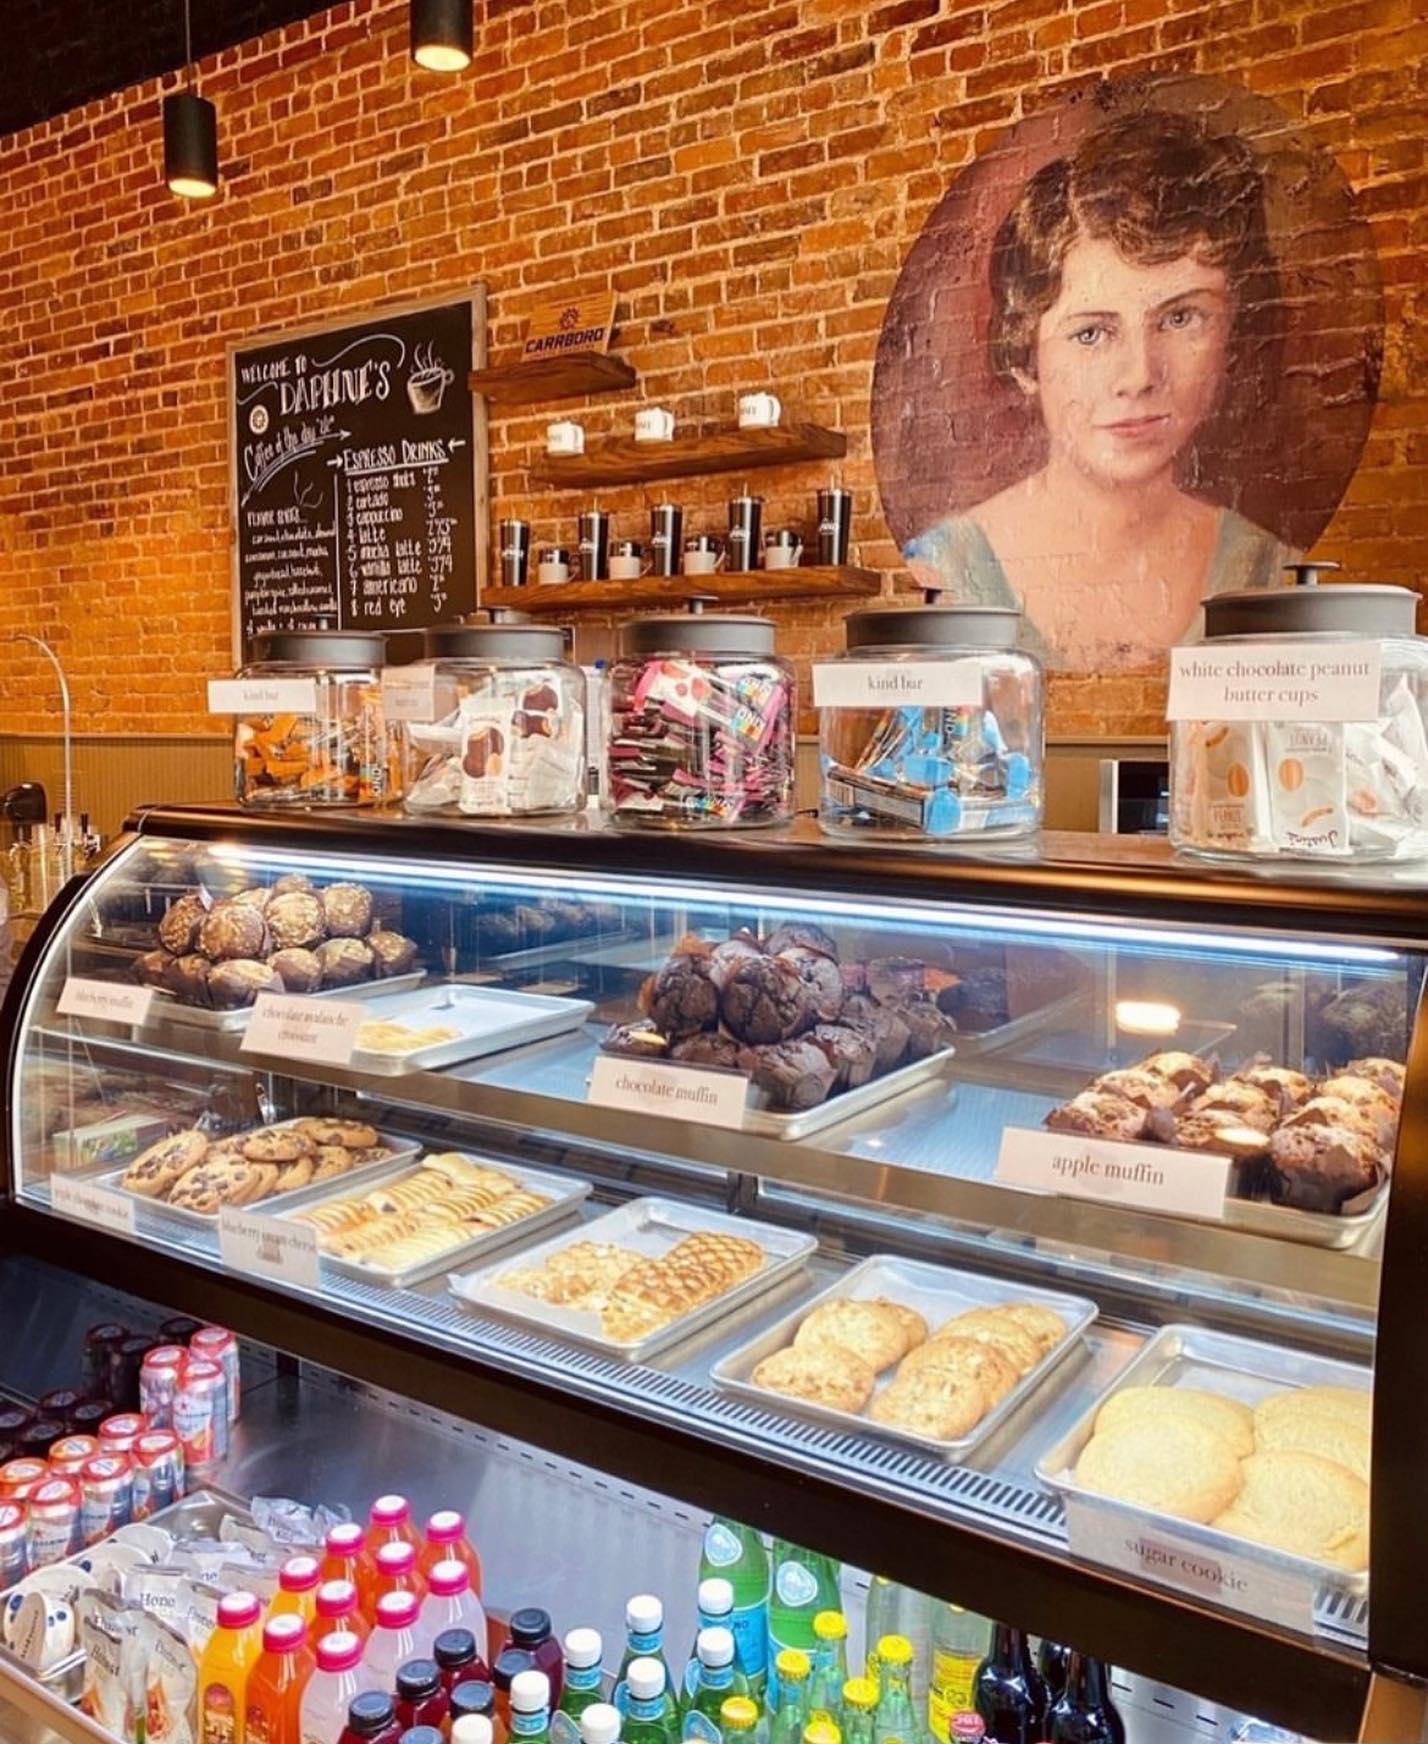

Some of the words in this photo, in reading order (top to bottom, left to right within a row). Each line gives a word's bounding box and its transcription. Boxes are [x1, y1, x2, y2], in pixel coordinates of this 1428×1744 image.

[525, 327, 605, 353] CARRBORO
[241, 357, 291, 384] WELCOME
[295, 354, 307, 375] TO
[279, 359, 391, 416] DAPHNE'S
[343, 445, 396, 471] ESPRESSO
[401, 438, 447, 464] DRINKS
[867, 675, 898, 690] kind
[901, 675, 923, 690] bar
[1181, 661, 1222, 678] white
[1226, 660, 1306, 678] chocolate
[1310, 662, 1369, 681] peanut
[1224, 686, 1273, 702] butter
[1277, 689, 1320, 707] cups
[616, 1074, 675, 1097] chocolate
[676, 1085, 719, 1105] muffin
[1052, 1156, 1100, 1178] apple
[1104, 1162, 1164, 1185] muffin
[1125, 1539, 1177, 1567] sugar
[1181, 1560, 1249, 1592] cookie
